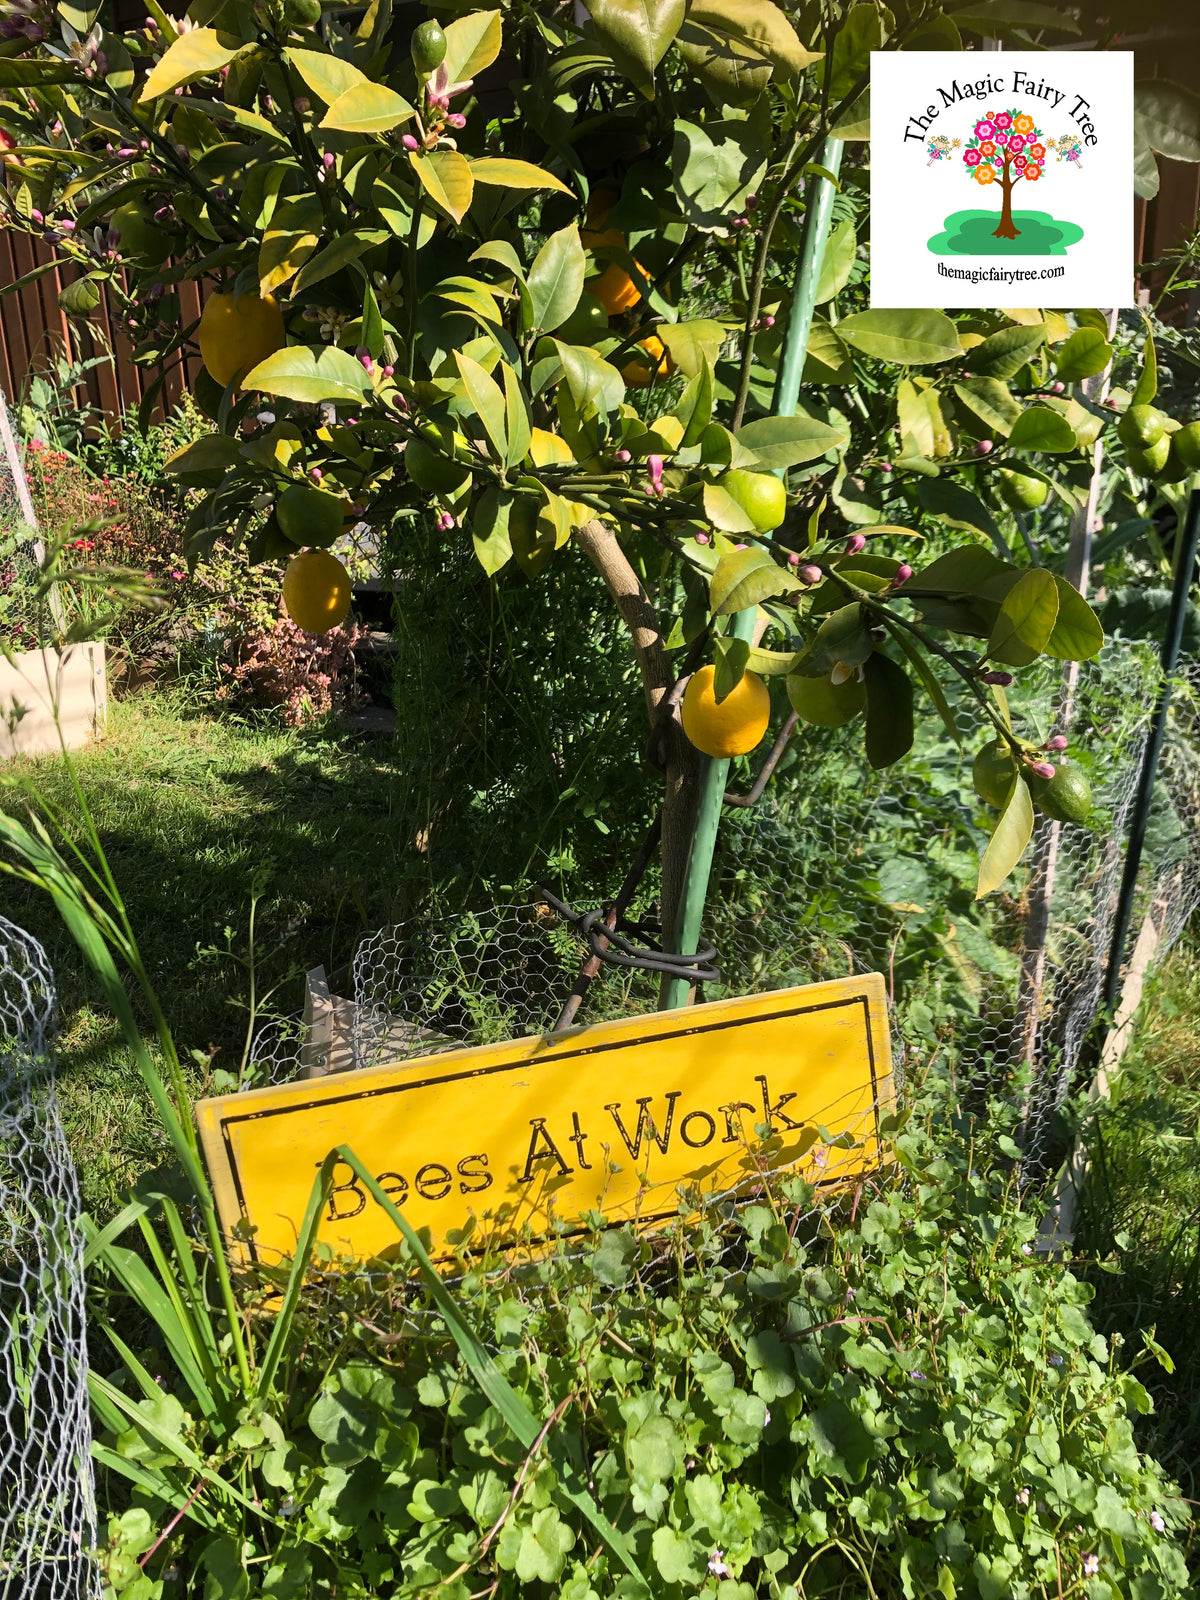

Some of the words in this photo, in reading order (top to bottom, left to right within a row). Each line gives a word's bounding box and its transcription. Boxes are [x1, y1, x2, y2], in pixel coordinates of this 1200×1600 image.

[315, 1153, 494, 1222] Bees
[517, 1111, 593, 1183] At
[604, 1074, 805, 1160] Work
